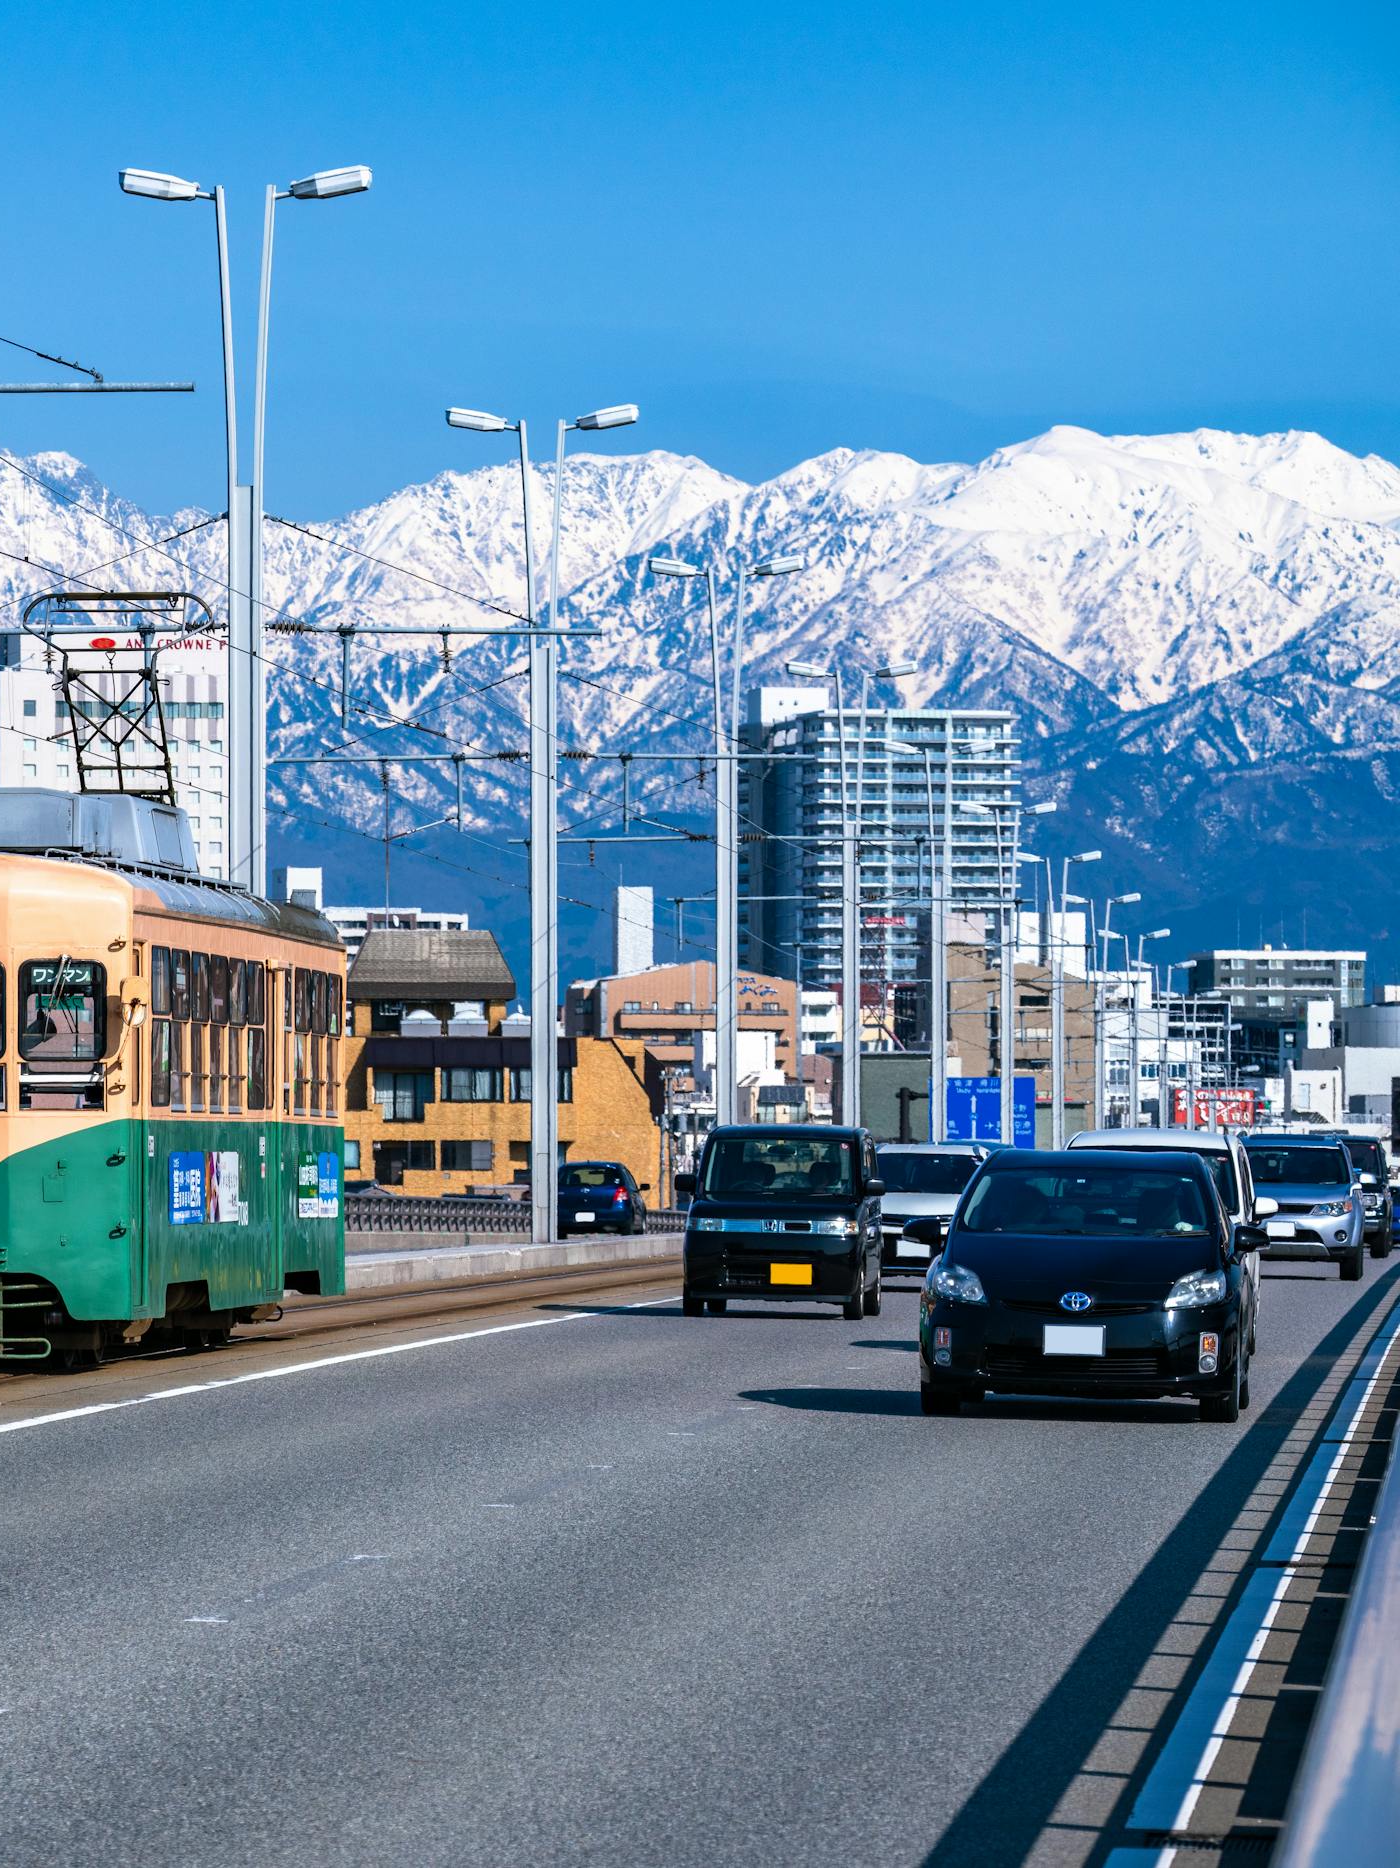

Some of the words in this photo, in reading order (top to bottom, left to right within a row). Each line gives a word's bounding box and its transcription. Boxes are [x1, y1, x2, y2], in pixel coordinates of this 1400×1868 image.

[157, 639, 212, 650] CROWNE
[33, 968, 89, 983] ワンマン
